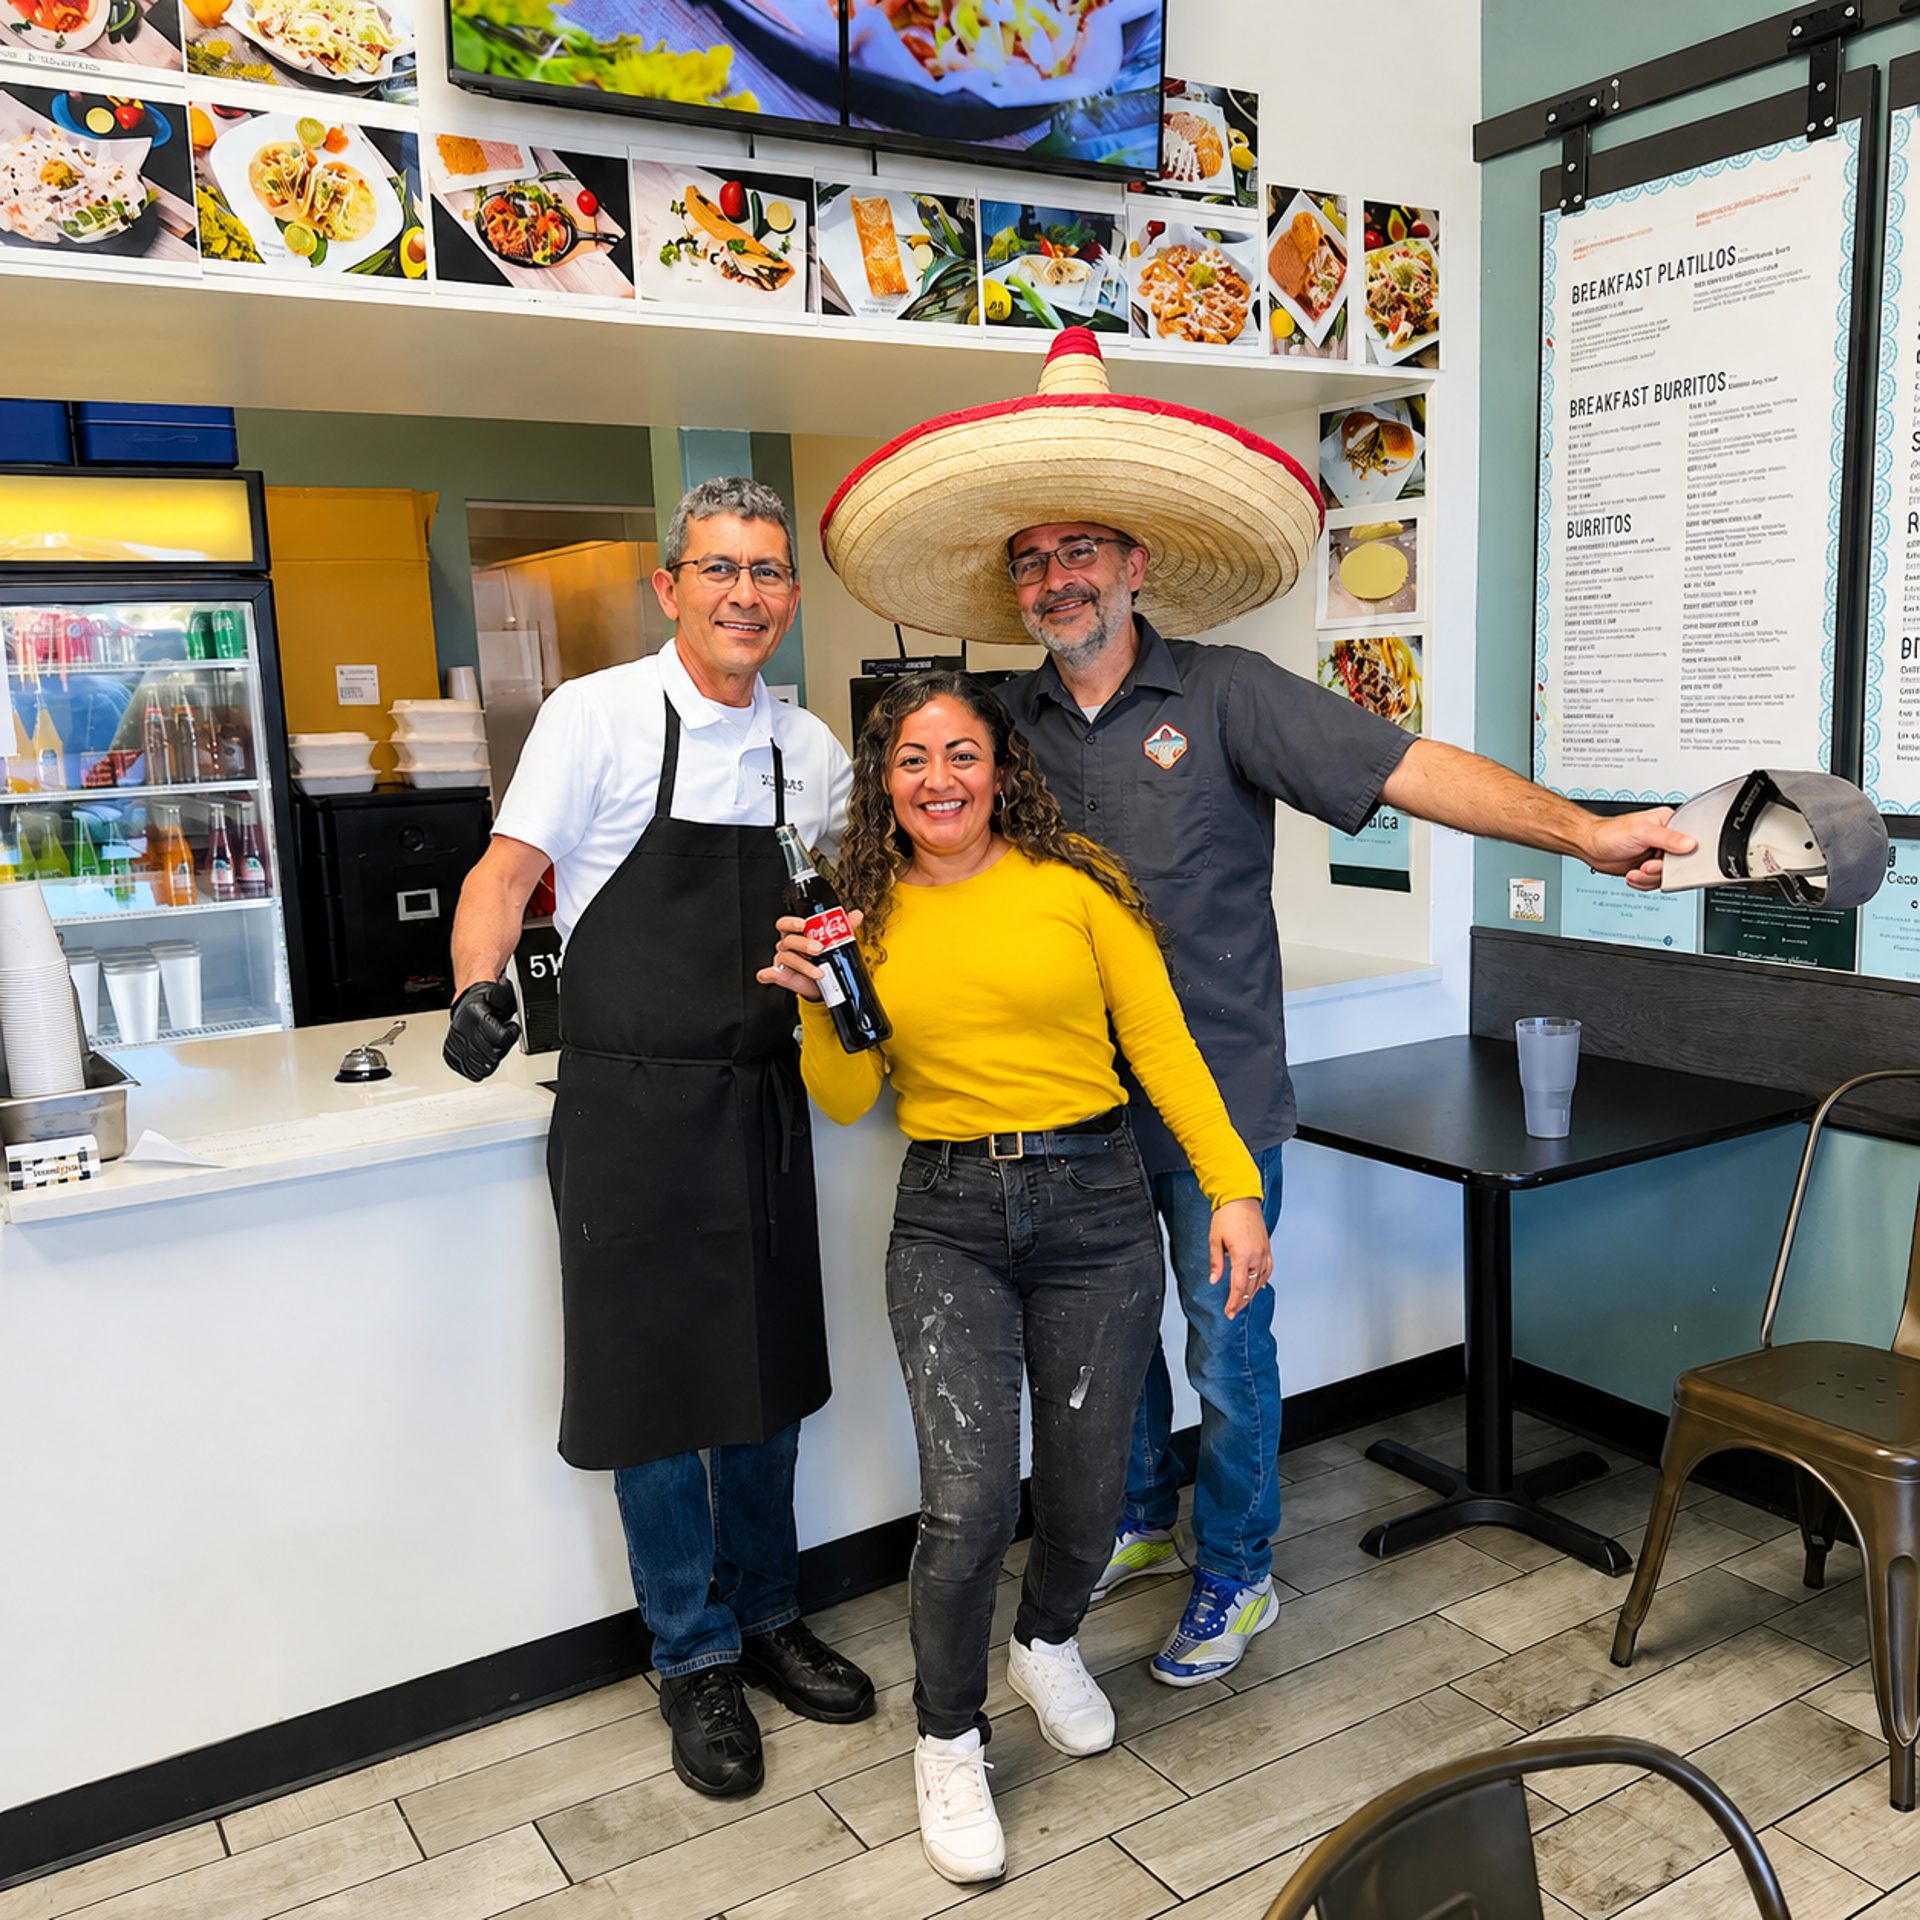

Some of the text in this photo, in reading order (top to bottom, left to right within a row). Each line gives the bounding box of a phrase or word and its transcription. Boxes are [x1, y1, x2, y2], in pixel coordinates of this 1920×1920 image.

[1571, 266, 1653, 305] BREAKFAST
[1657, 245, 1737, 284] PLATILLOS
[1570, 386, 1649, 418] BREAKFAST
[1654, 371, 1728, 403] BURRITOS
[1567, 513, 1632, 539] BURRITOS
